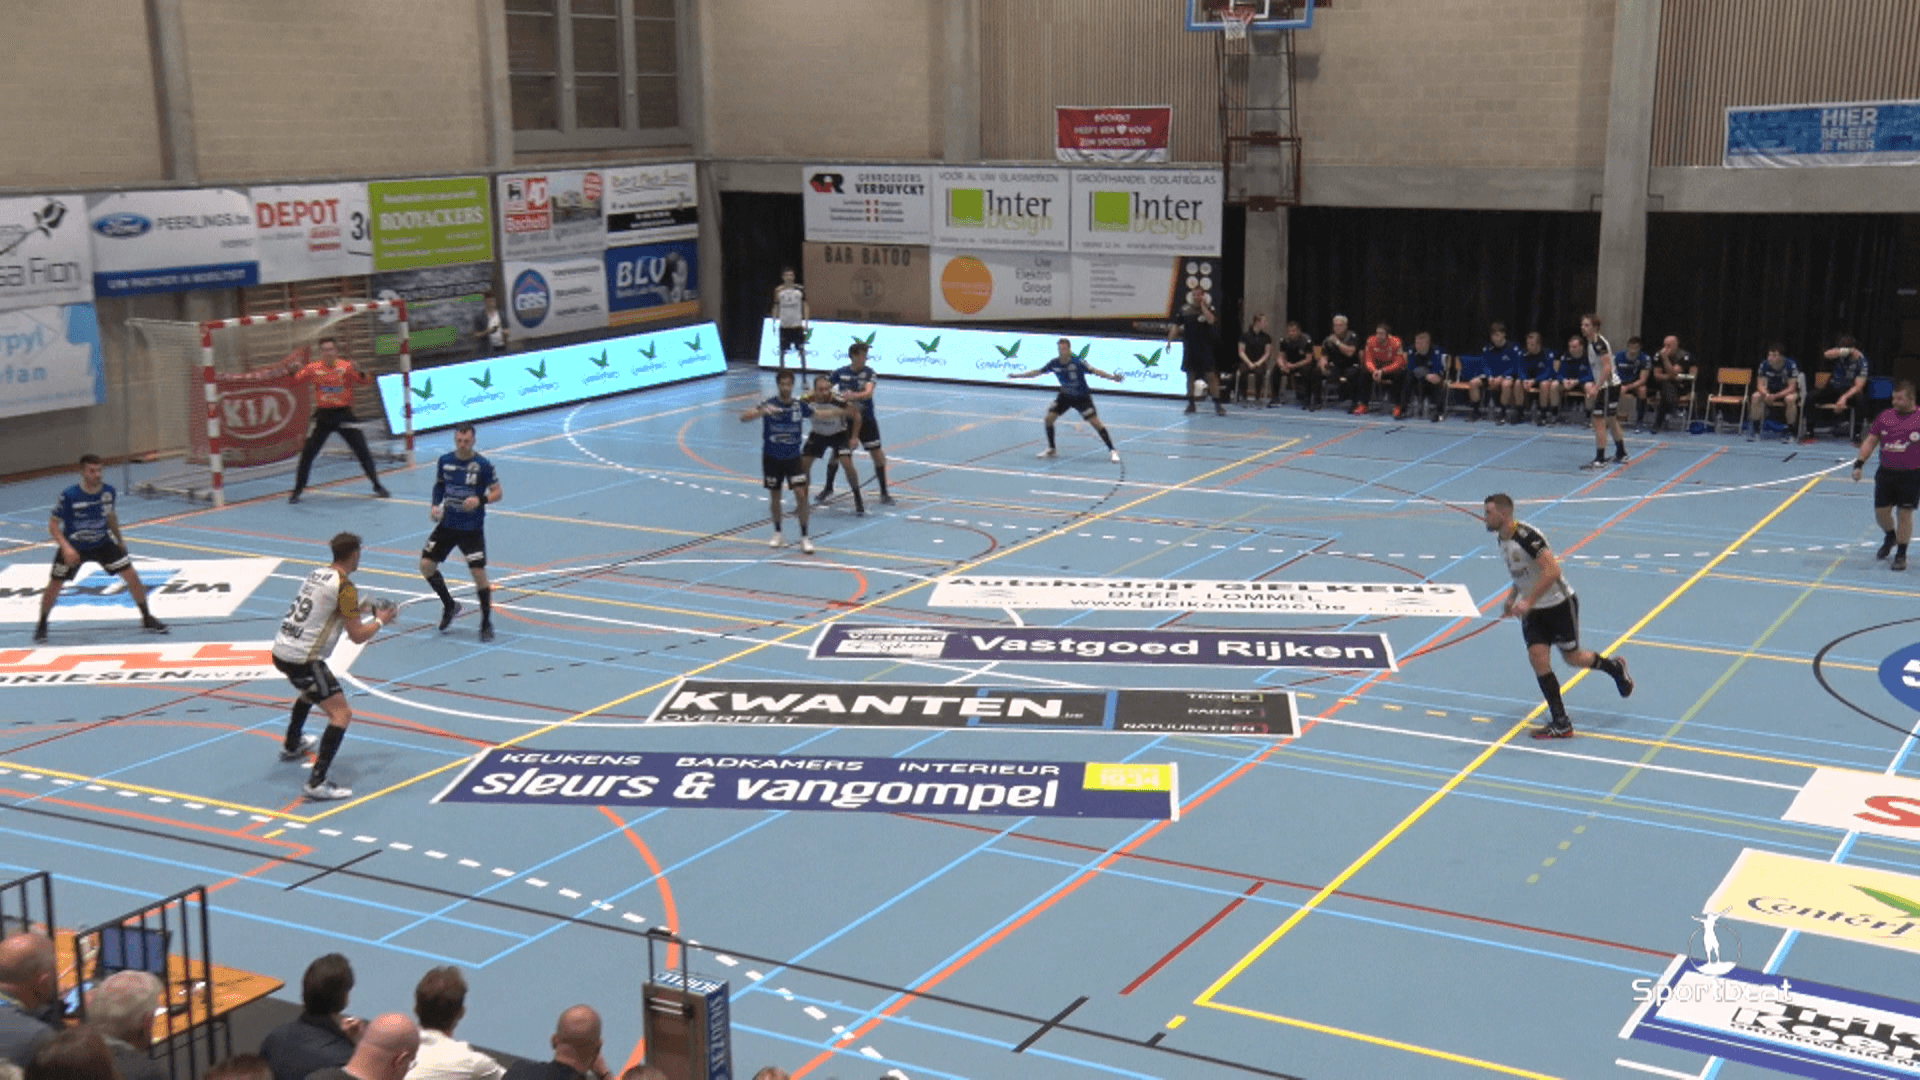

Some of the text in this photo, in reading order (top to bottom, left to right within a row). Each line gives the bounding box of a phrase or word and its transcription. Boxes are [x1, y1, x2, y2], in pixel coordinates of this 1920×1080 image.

[1821, 107, 1878, 126] HIER
[1821, 127, 1876, 140] BELEEF
[1837, 140, 1875, 151] MEER
[858, 173, 922, 182] GEBROEDERS
[939, 172, 1059, 183] VOOR AL UW GLASWERKEN
[1076, 174, 1217, 185] GROOTHANDEL ISOLATIEGLAS
[855, 184, 925, 195] VERDUYCKT
[986, 189, 1053, 218] Inter
[1133, 191, 1204, 220] Inter
[157, 213, 249, 230] PEERLINGS.be
[256, 198, 340, 229] DEPOT
[379, 206, 484, 231] ROOYACKERS
[987, 210, 1053, 236] Design
[1133, 214, 1204, 240] Design
[825, 246, 911, 267] BAR BATOO
[1034, 257, 1052, 267] Uw
[616, 257, 666, 287] BLV
[1016, 268, 1052, 280] Elektro
[1022, 282, 1052, 294] Groot
[1015, 295, 1052, 307] Handel
[222, 395, 282, 427] KIA
[949, 579, 1456, 594] Autobedrijf GIELKENS
[1108, 591, 1179, 599] BREE
[1207, 593, 1322, 601] LOMMEL
[848, 631, 947, 641] Vastgoed
[971, 635, 1375, 660] Vastgoed Rijken
[669, 691, 1063, 718] KWANTEN
[661, 713, 799, 723] OVERPELT
[1123, 722, 1255, 732] NATUURSTEEN
[500, 753, 1060, 775] KEUKENS BADKAMERS INTERIEUR
[472, 767, 1059, 811] sleurs & vangompel
